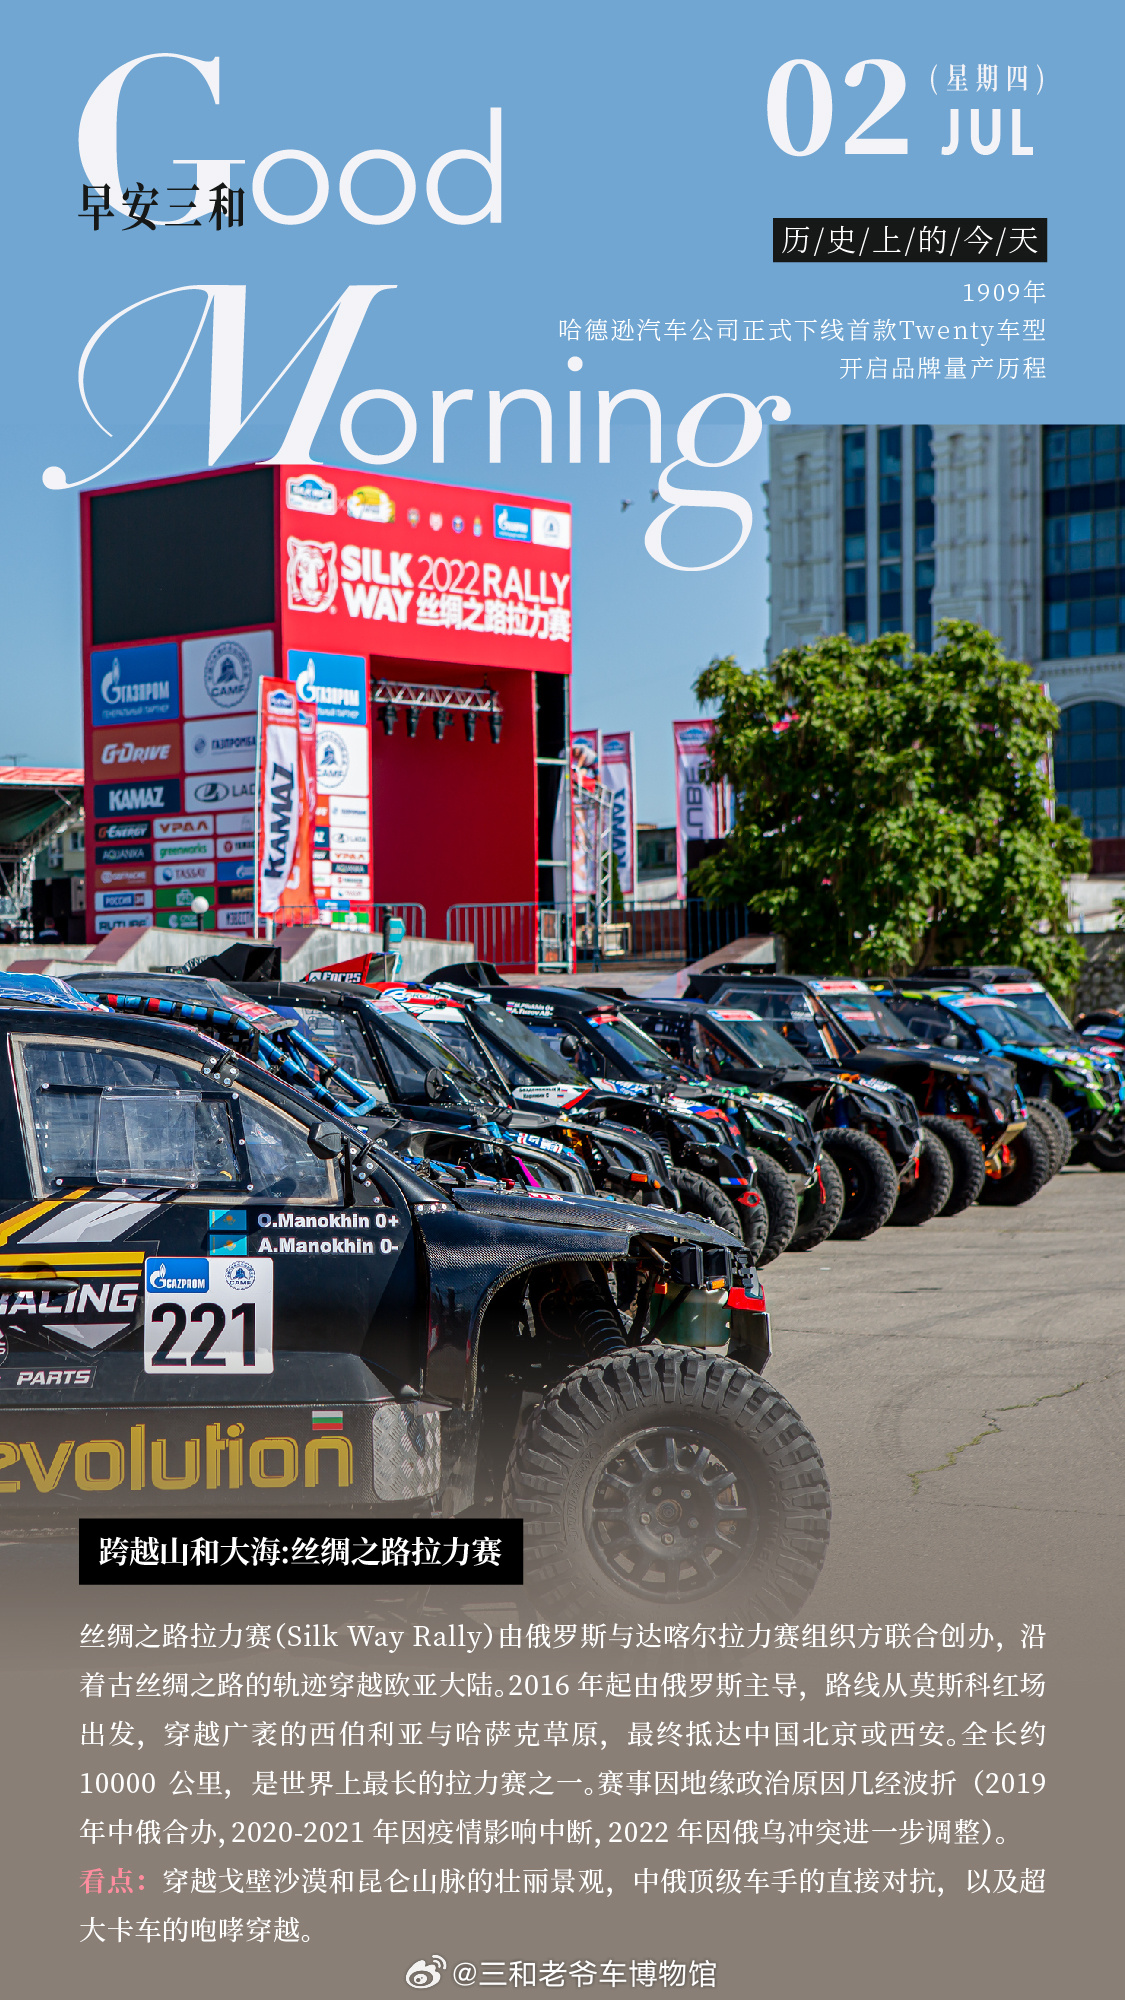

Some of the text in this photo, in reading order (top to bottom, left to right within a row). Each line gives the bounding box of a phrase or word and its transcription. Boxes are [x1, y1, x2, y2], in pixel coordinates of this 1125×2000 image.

[341, 545, 571, 606] SILK 2022 RALLY
[341, 582, 571, 643] WAY 丝绸之路拉力赛
[109, 786, 165, 812] KAMAZ
[265, 762, 294, 878] KAMAZ
[257, 1212, 400, 1229] O.Manokhin 0+
[257, 1237, 374, 1254] A.Manokhin
[166, 1278, 206, 1289] GAZPROM
[151, 1302, 256, 1367] 221
[16, 1369, 92, 1386] PARTS
